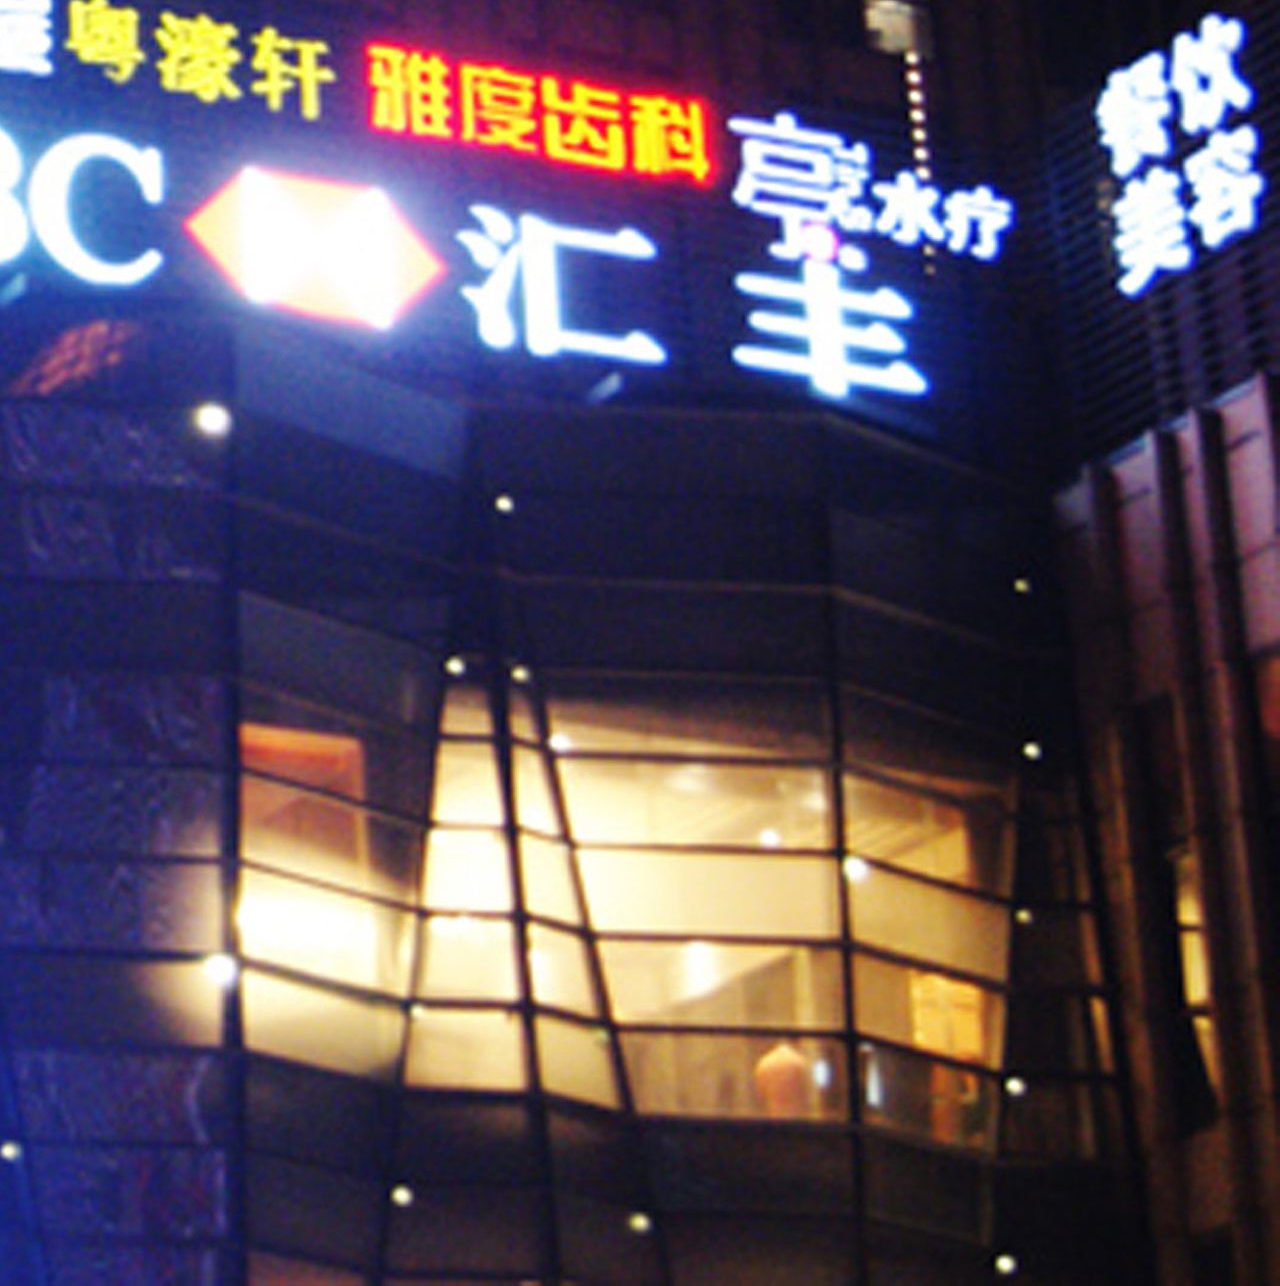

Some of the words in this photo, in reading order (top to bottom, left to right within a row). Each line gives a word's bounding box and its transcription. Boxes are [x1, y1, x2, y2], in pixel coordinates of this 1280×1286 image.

[363, 42, 714, 188] 雅度齿科
[455, 202, 930, 402] 汇丰
